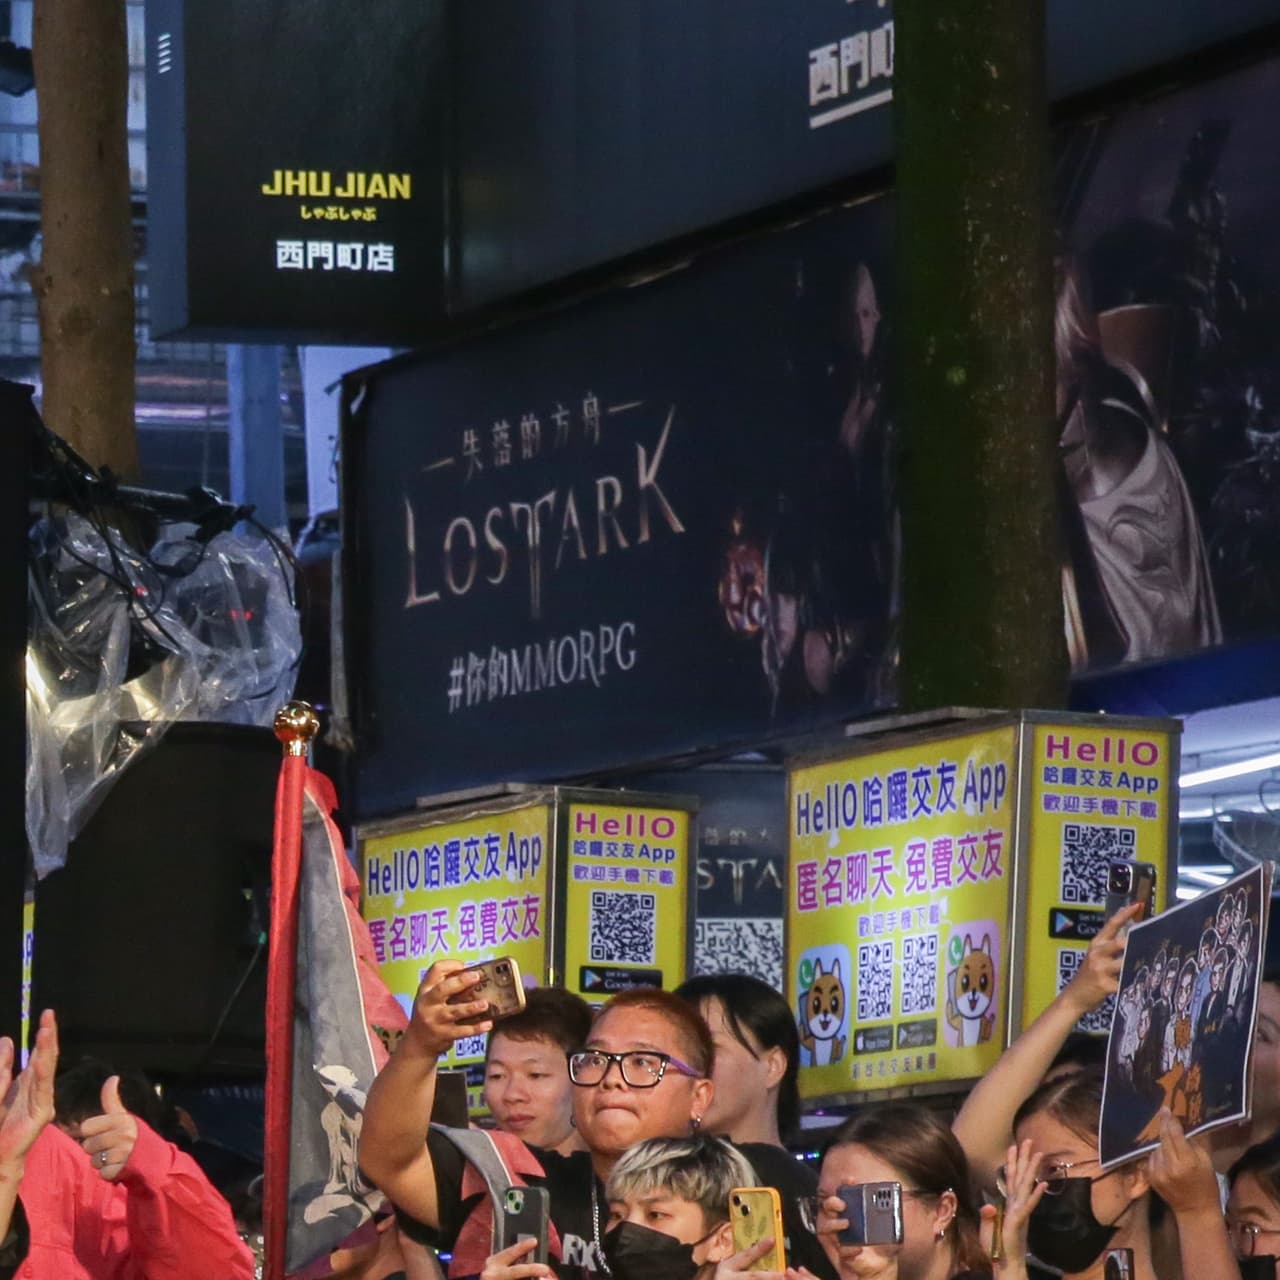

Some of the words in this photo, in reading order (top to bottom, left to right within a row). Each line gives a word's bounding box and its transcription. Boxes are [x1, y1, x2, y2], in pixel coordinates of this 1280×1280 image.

[262, 170, 331, 196] JHU
[335, 172, 412, 199] JIAN
[300, 205, 377, 222] しゃぶしゃぶ
[276, 239, 395, 272] 西門町店
[796, 849, 894, 912] 匿名聊天
[905, 828, 1004, 893] 免費交友
[458, 893, 541, 949] 免費交友
